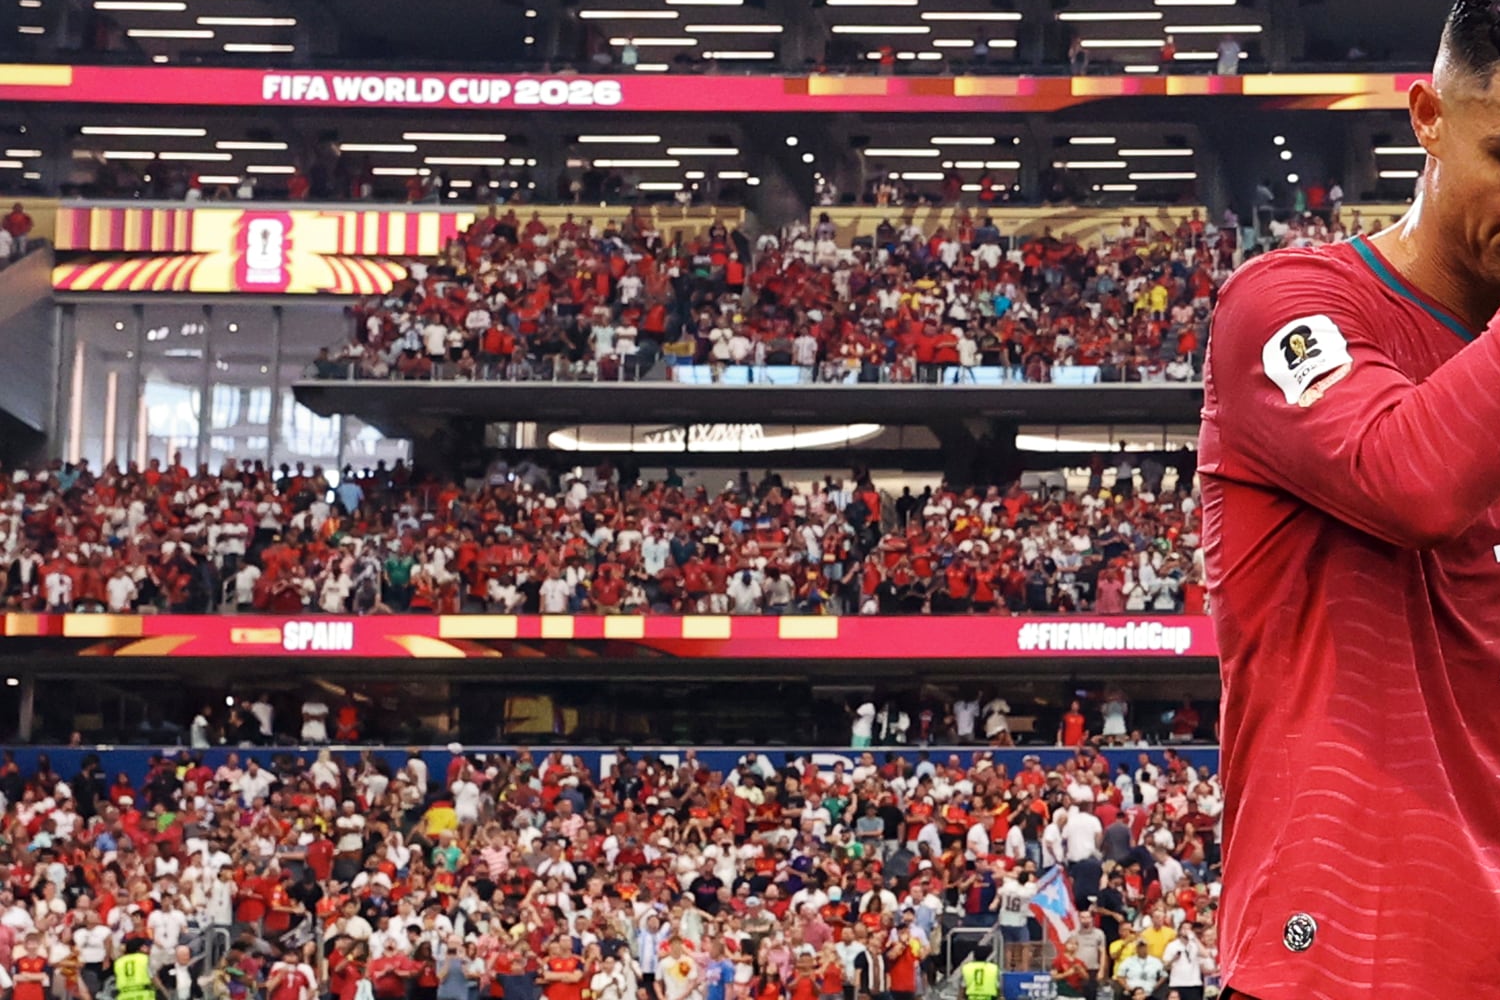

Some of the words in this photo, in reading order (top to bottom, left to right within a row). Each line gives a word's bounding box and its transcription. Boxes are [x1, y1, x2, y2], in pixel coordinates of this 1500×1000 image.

[262, 75, 330, 101] FIFA
[332, 76, 446, 103] WORLD
[448, 78, 512, 104] CUP
[513, 80, 622, 106] 2026
[283, 621, 354, 650] SPAIN
[1018, 622, 1192, 655] #FIFAWorldCup
